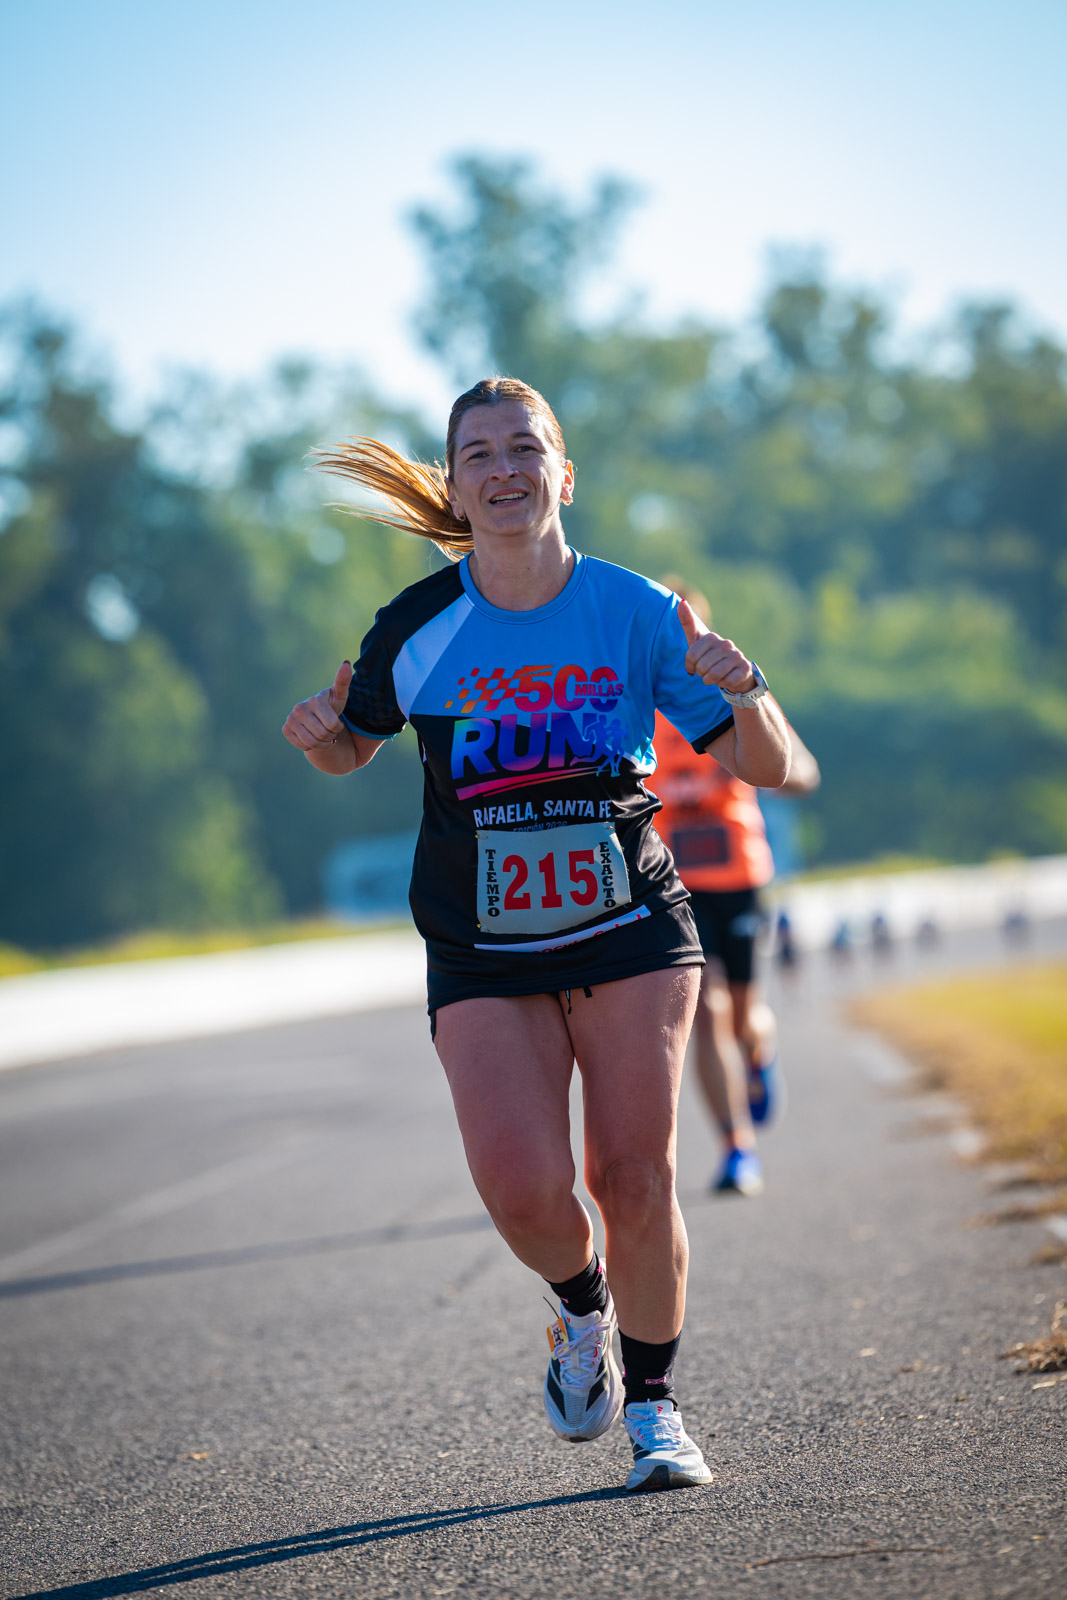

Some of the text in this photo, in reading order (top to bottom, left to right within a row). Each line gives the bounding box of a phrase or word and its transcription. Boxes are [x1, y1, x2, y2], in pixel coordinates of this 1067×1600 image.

[574, 683, 624, 697] MILLAS
[451, 713, 605, 780] RUN
[473, 800, 612, 828] RAFAELA, SANTA FE
[485, 849, 500, 917] TIEMPO
[502, 849, 598, 910] 215
[599, 842, 616, 908] EXACTO
